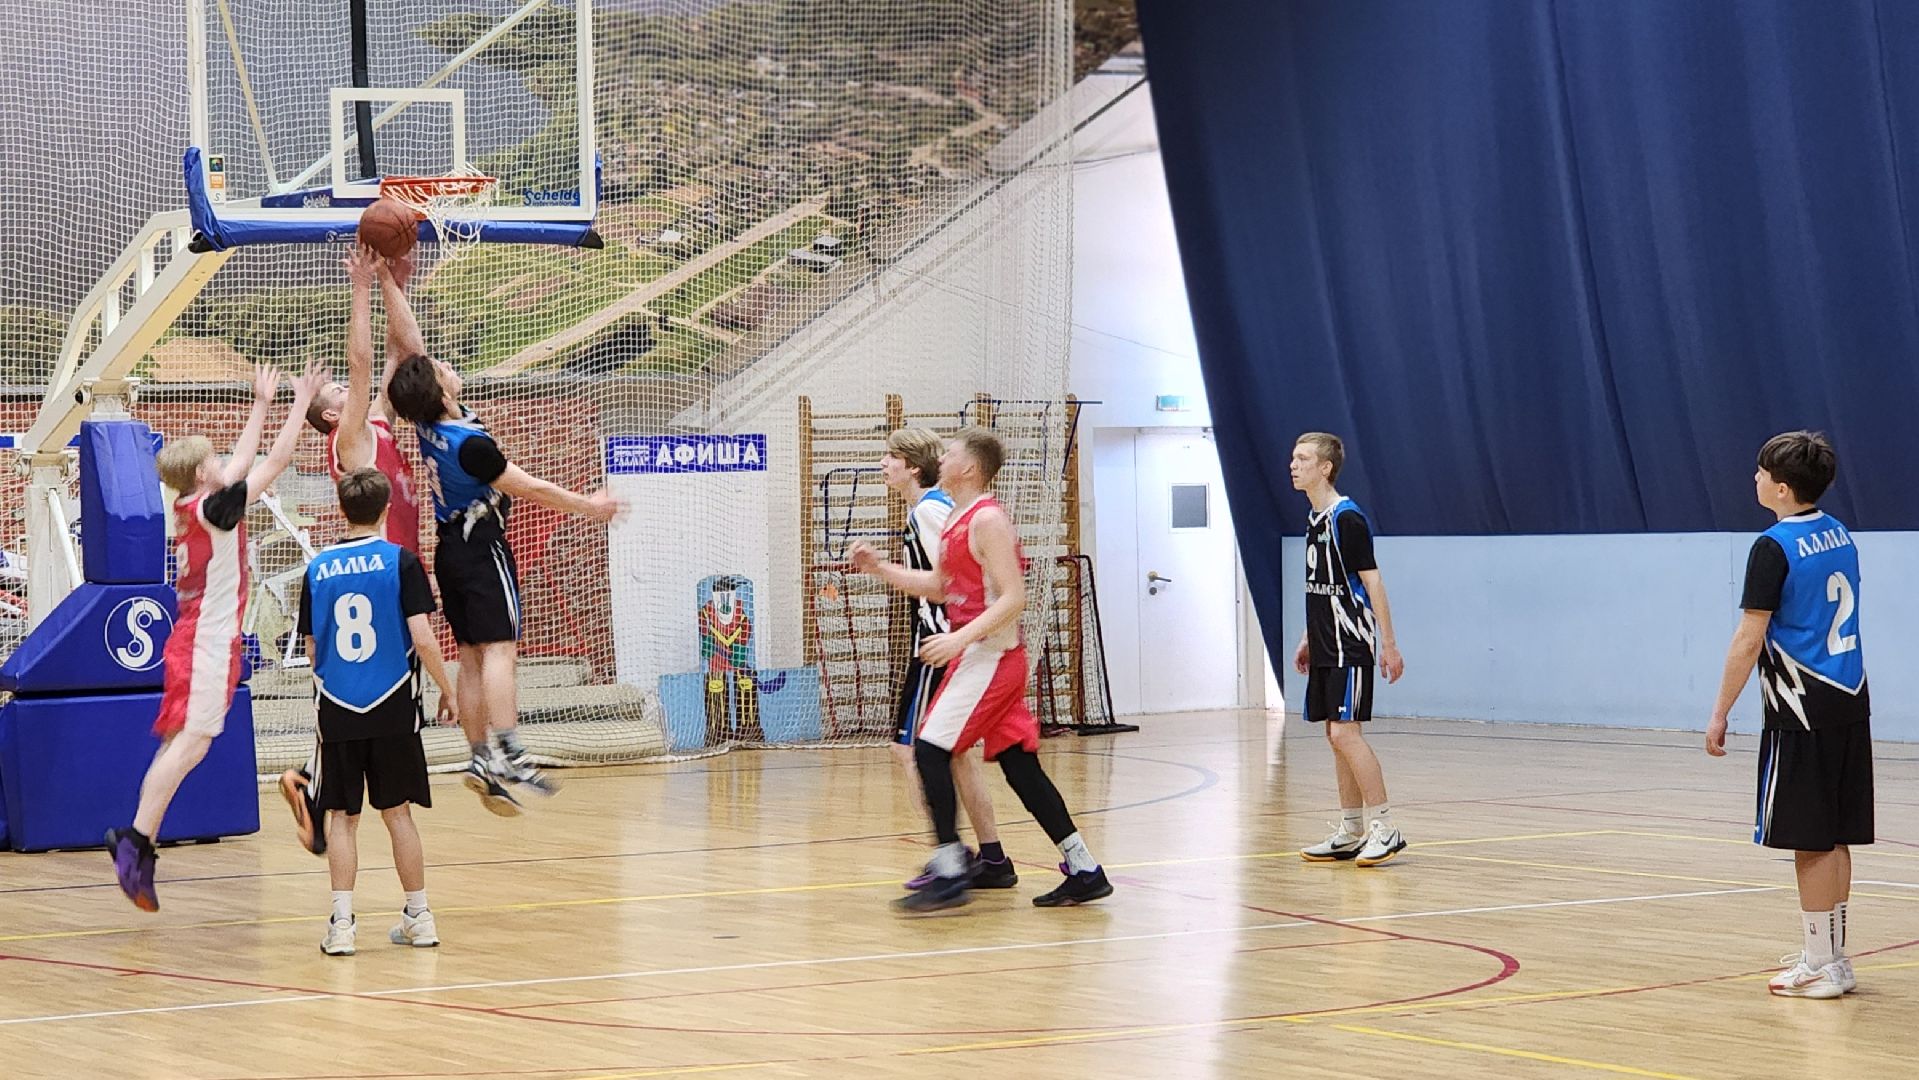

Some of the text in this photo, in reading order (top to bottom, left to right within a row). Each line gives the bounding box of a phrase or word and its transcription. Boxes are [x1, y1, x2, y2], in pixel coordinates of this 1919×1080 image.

[523, 189, 580, 206] Schelde
[656, 442, 760, 466] АФИША
[1796, 526, 1850, 557] ЛАМА
[316, 554, 385, 581] ЛАМА
[1307, 543, 1317, 580] 9
[334, 592, 377, 663] 8
[1827, 571, 1856, 656] 2
